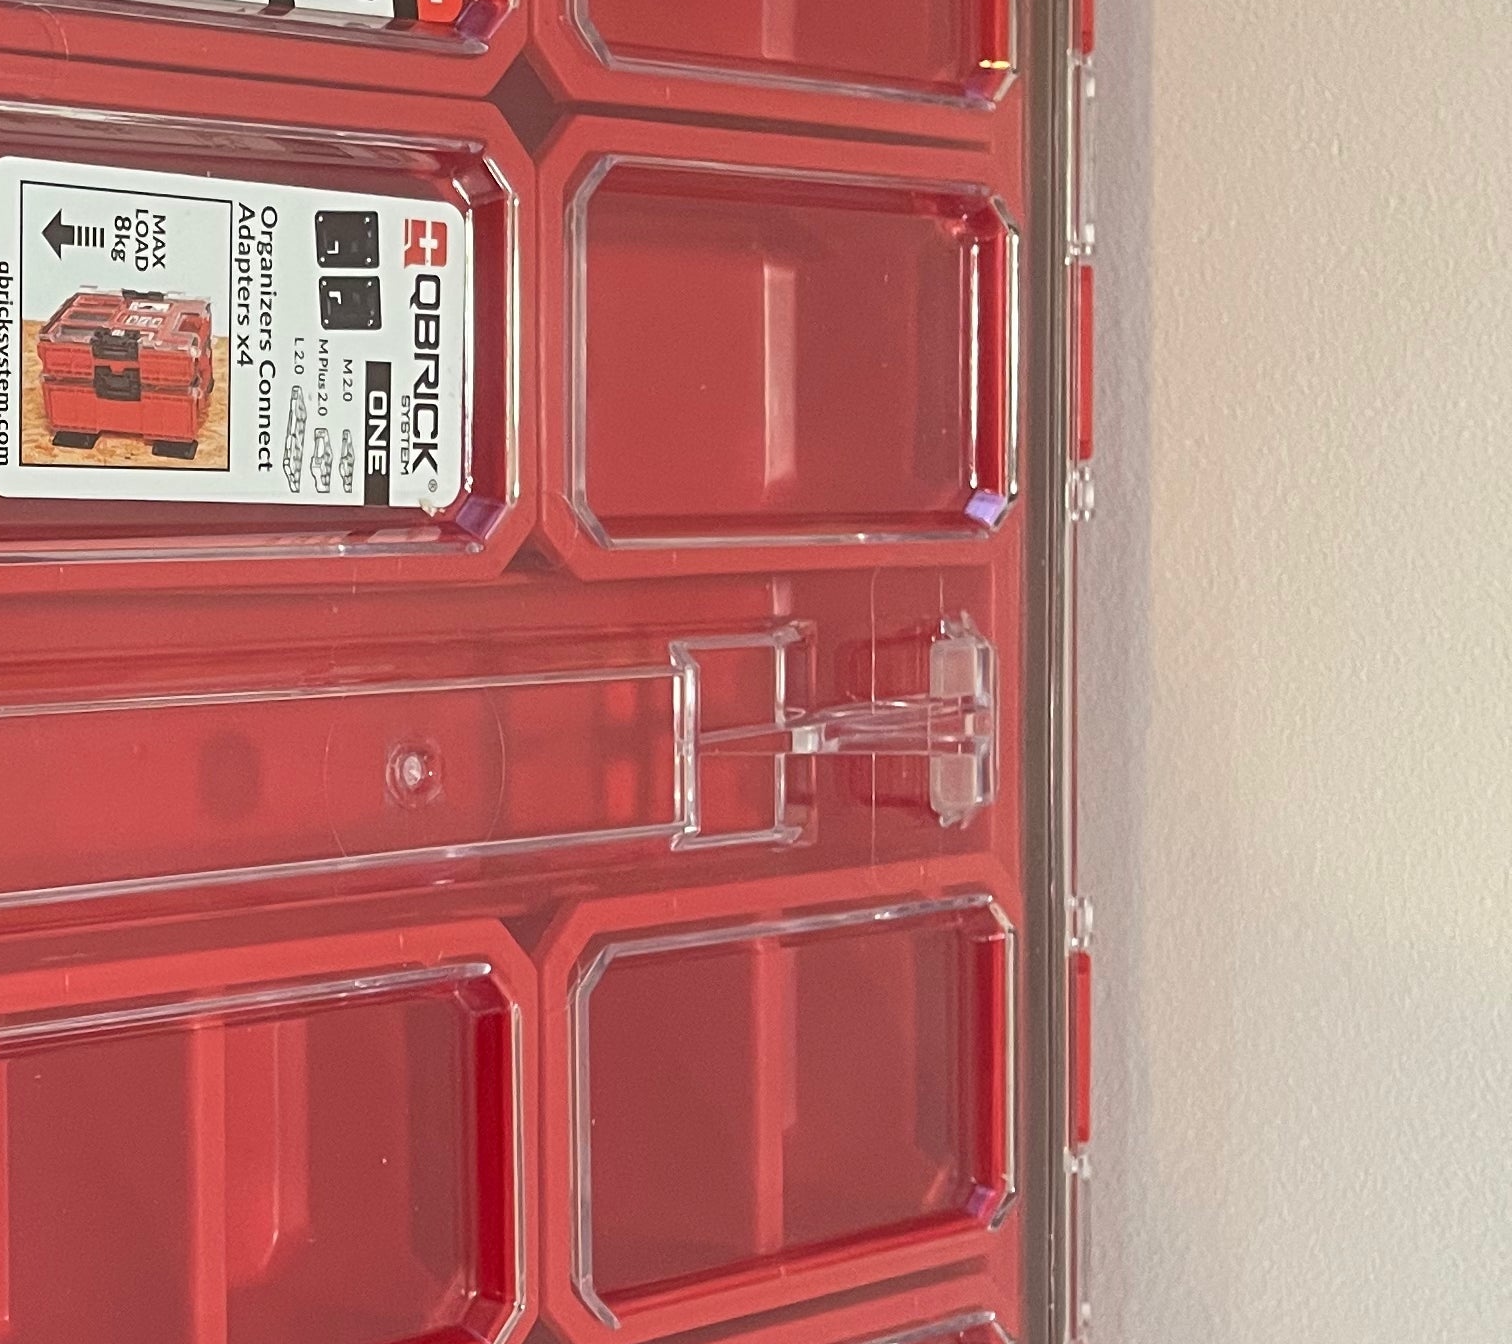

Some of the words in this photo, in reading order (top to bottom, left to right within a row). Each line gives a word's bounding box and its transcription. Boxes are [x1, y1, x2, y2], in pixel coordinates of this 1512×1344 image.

[111, 215, 131, 263] 8kg
[135, 208, 149, 272] LOAD
[152, 214, 166, 269] MAX
[235, 202, 255, 326] Adapters
[256, 205, 278, 351] Organizers
[237, 335, 253, 367] x4
[294, 351, 304, 375] 2.0
[318, 339, 328, 355] M
[343, 359, 352, 374] M
[318, 357, 328, 390] Plus
[343, 378, 353, 402] 2.0
[410, 274, 441, 475] QBRICK
[259, 360, 276, 472] Connect
[318, 392, 328, 416] 2.0
[368, 390, 387, 475] ONE
[401, 395, 411, 475] SYSTEM
